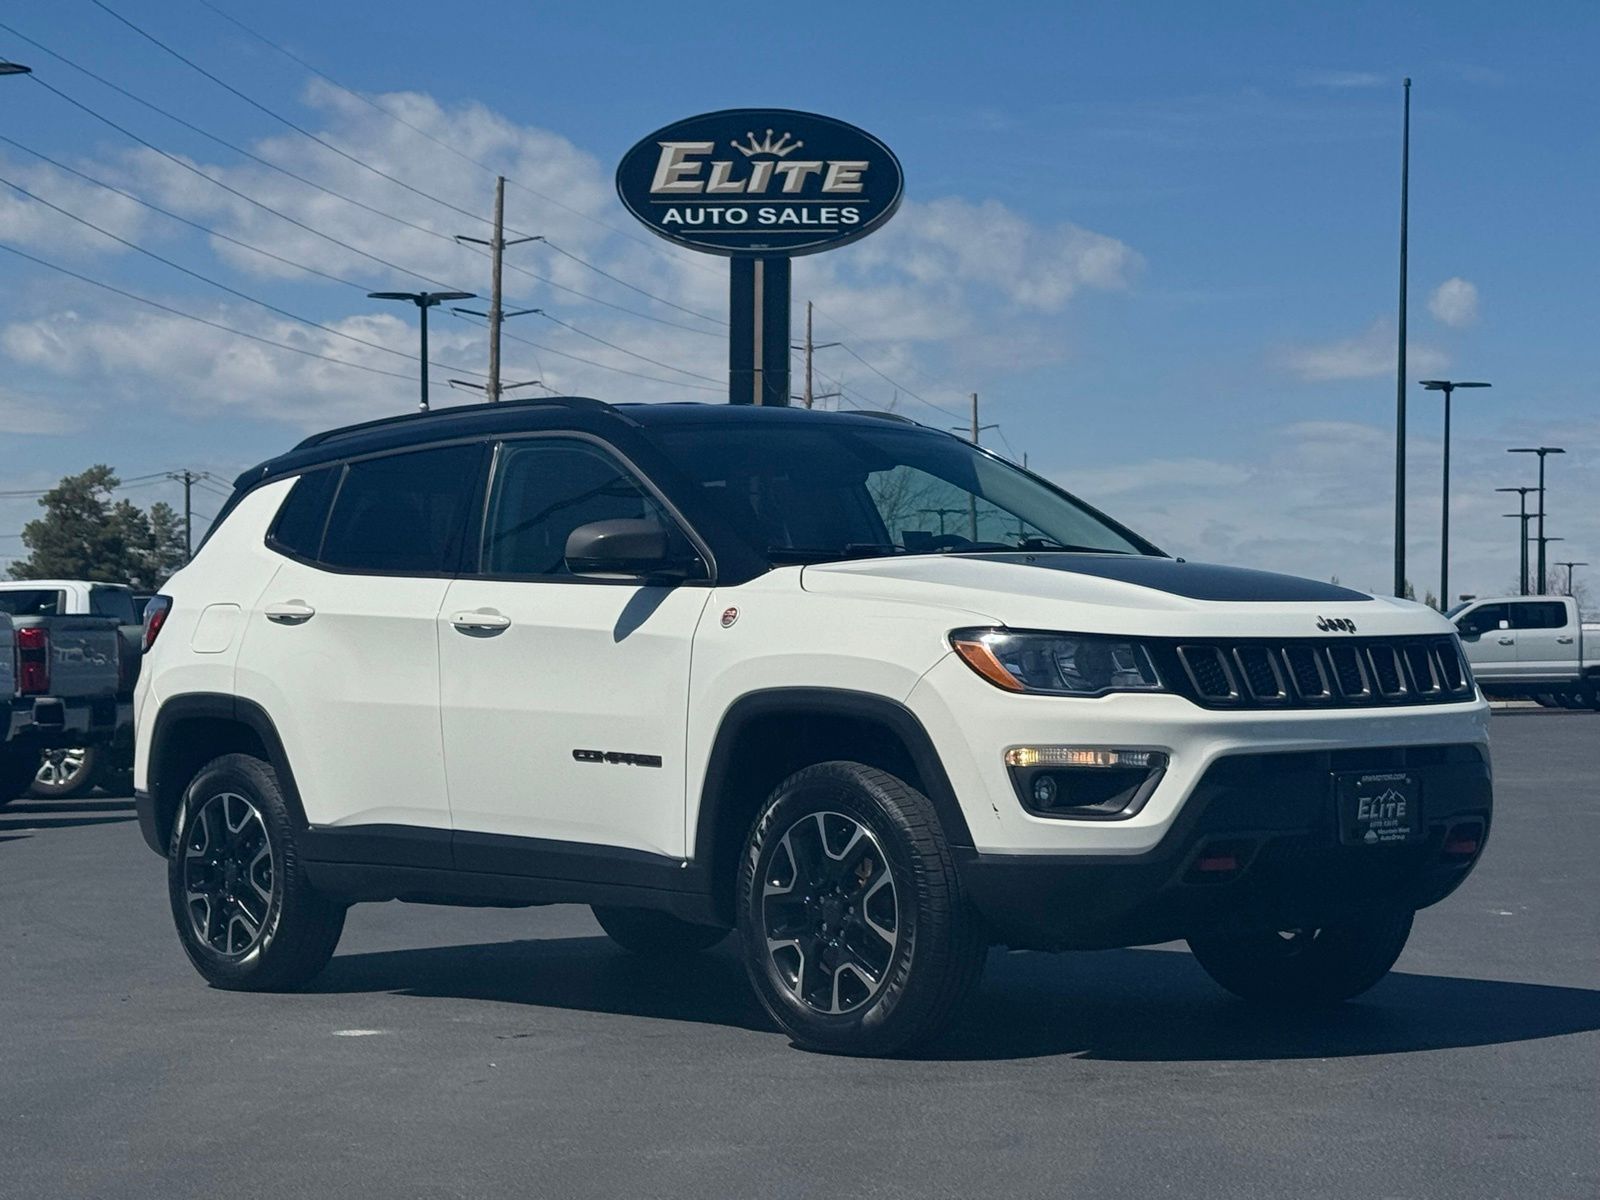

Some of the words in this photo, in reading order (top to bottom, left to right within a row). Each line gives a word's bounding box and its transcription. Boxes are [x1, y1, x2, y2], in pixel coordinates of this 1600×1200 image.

[650, 141, 869, 193] ELITE
[662, 208, 748, 224] AUTO
[757, 207, 859, 224] SALES
[1316, 615, 1357, 634] Jeep
[1357, 797, 1407, 820] ELITE
